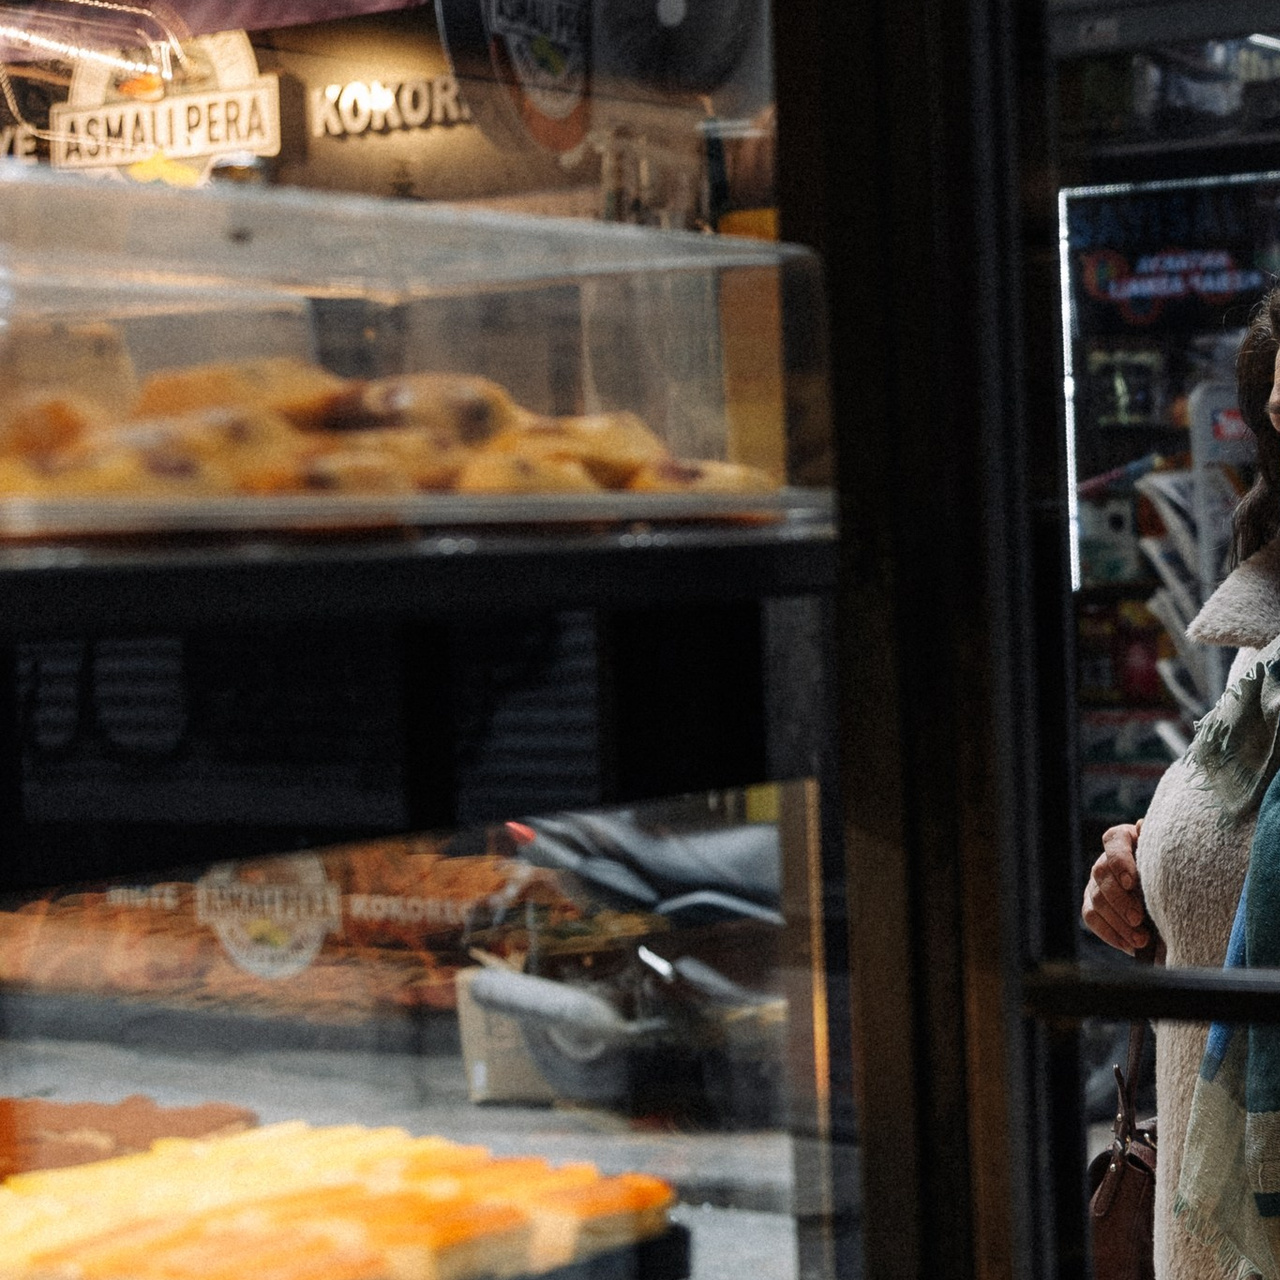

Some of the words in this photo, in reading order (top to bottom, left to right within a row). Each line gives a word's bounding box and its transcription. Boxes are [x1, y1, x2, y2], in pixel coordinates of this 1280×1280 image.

[64, 107, 174, 160] ASMALI
[187, 95, 266, 148] PERA
[311, 75, 472, 138] KOKOR
